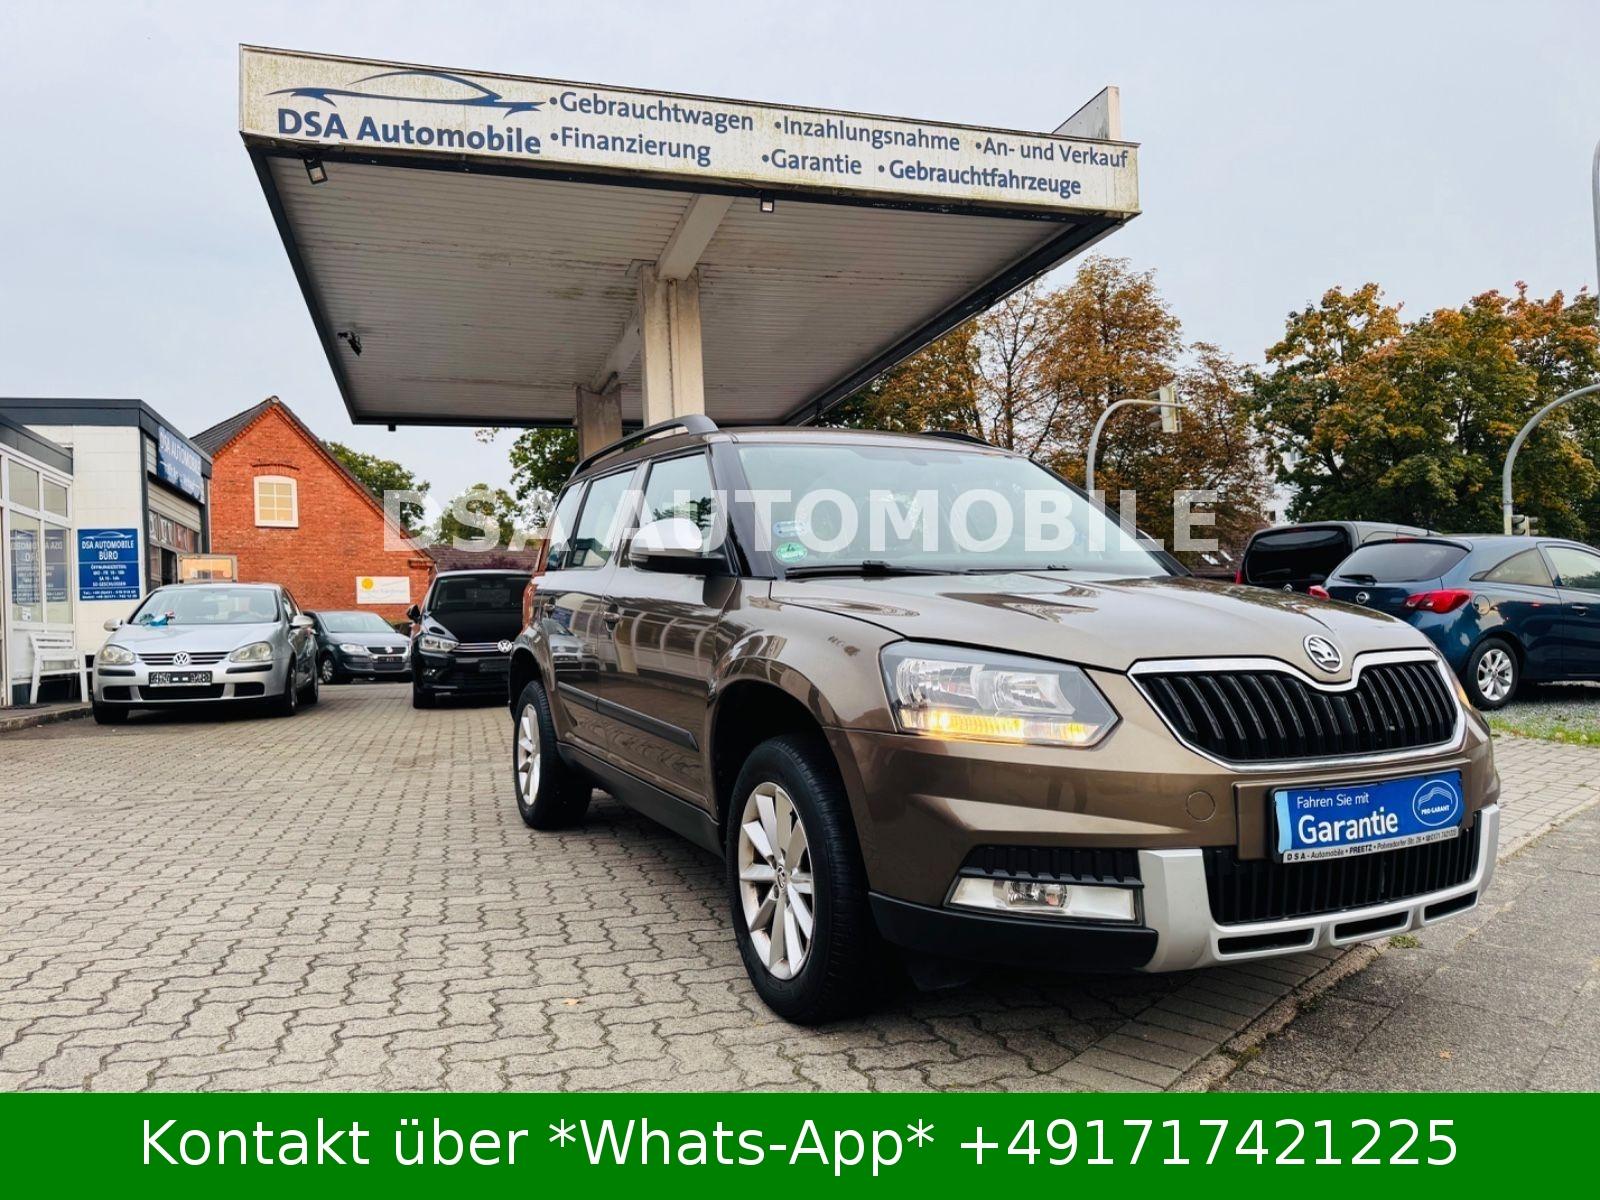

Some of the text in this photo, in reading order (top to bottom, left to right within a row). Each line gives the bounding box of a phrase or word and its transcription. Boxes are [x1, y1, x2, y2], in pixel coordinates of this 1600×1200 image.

[559, 91, 754, 133] Gebrauchtwagen
[277, 107, 541, 154] DSA Automobile
[560, 126, 711, 167] Finanzierung
[782, 115, 960, 152] Inzahlungsnahme
[771, 148, 863, 175] Garantie
[983, 136, 1128, 169] An- und Verkauf
[889, 159, 1081, 198] Gebrauchtfahrzeuge
[81, 540, 134, 549] DSA AUTOMOBILE
[98, 549, 119, 560] BÜRO
[1296, 792, 1370, 809] Fahren Sie mit
[1298, 806, 1399, 845] Garantie
[1310, 848, 1344, 859] Automobile
[1349, 844, 1373, 854] PREETZ
